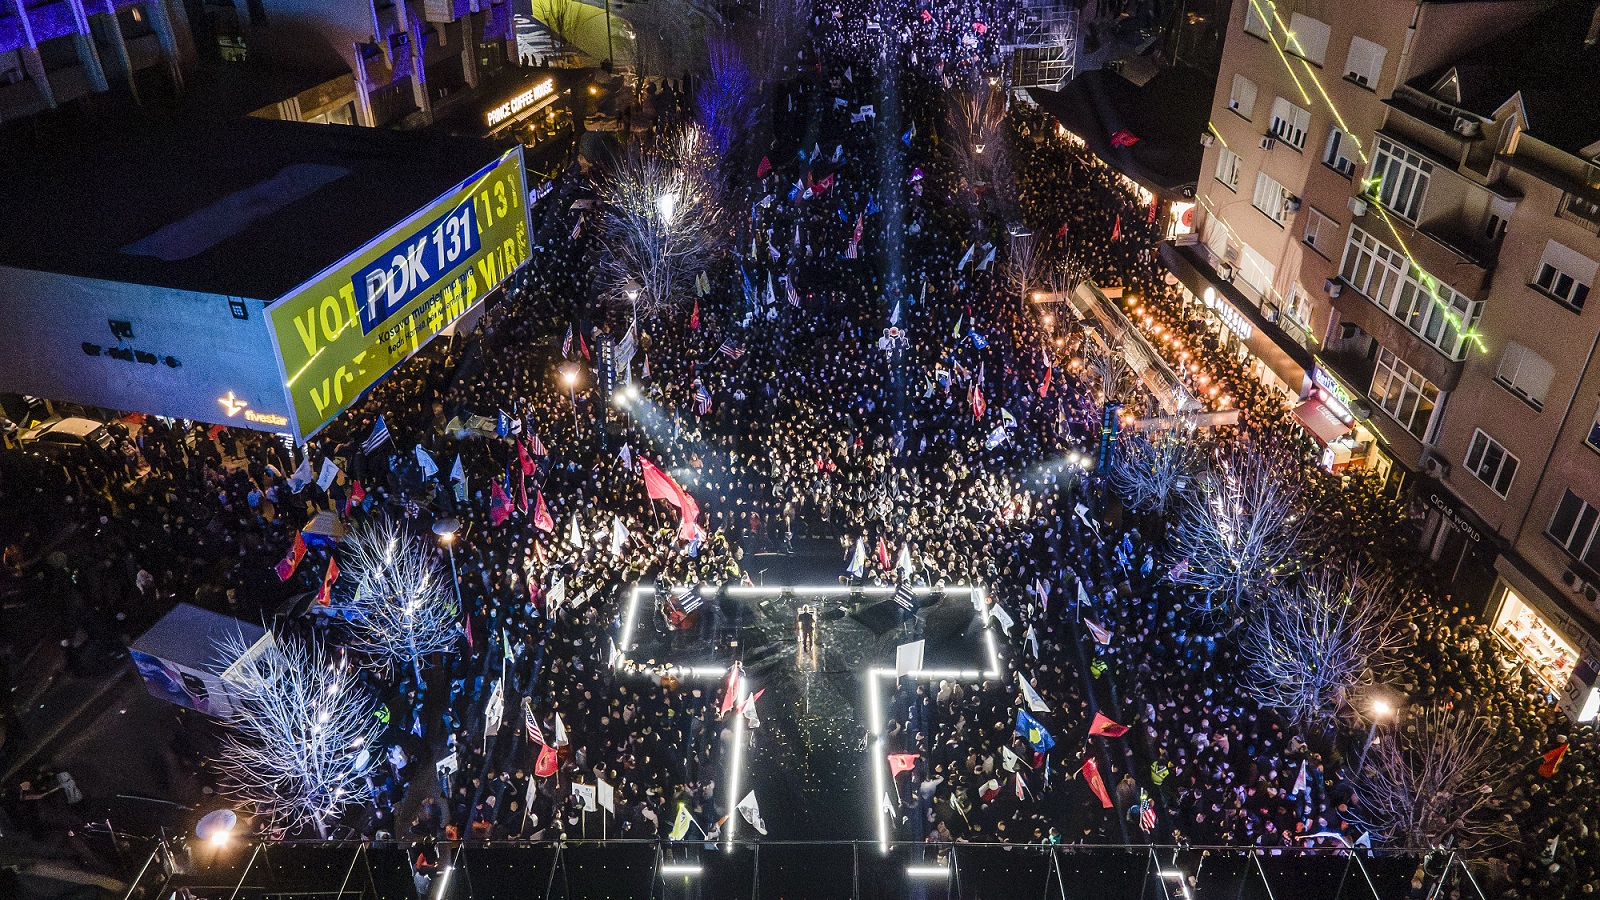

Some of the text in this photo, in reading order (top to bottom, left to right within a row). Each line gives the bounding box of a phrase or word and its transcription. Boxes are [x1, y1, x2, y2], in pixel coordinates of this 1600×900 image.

[487, 79, 554, 127] PRINCE COFFEE HOUSE
[365, 207, 471, 323] PDK 131
[244, 410, 288, 426] fivestar
[1430, 494, 1453, 516] CIGAR
[1454, 514, 1480, 542] WORLD
